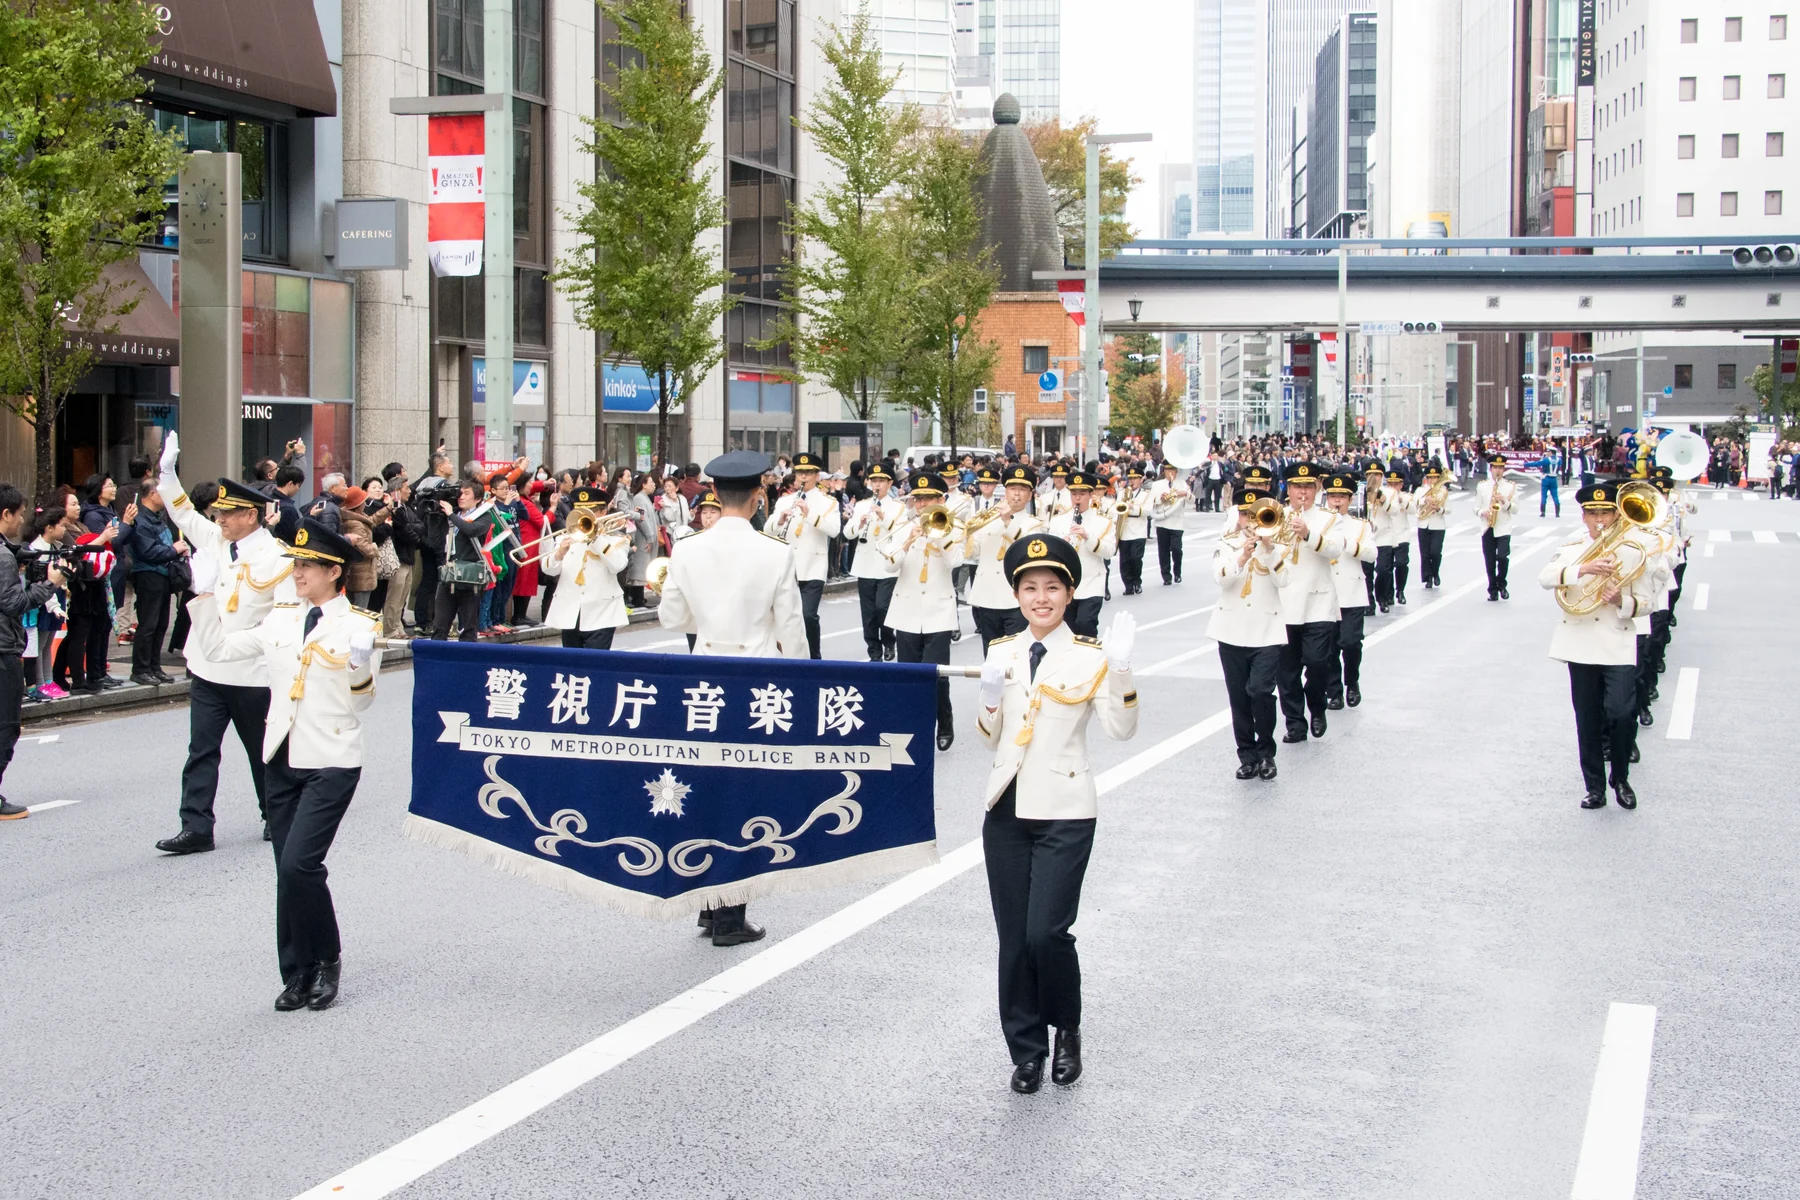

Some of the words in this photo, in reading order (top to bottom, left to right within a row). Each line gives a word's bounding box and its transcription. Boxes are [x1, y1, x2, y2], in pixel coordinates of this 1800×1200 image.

[184, 65, 248, 89] weddings
[342, 230, 393, 239] CAFERING
[101, 341, 171, 360] weddings
[605, 379, 637, 398] kinko's
[484, 667, 866, 737] 警視庁音楽隊
[471, 733, 531, 750] TOKYO
[551, 739, 700, 760] METROPOLITAN
[721, 748, 793, 764] POLICE
[815, 751, 871, 764] BAND
